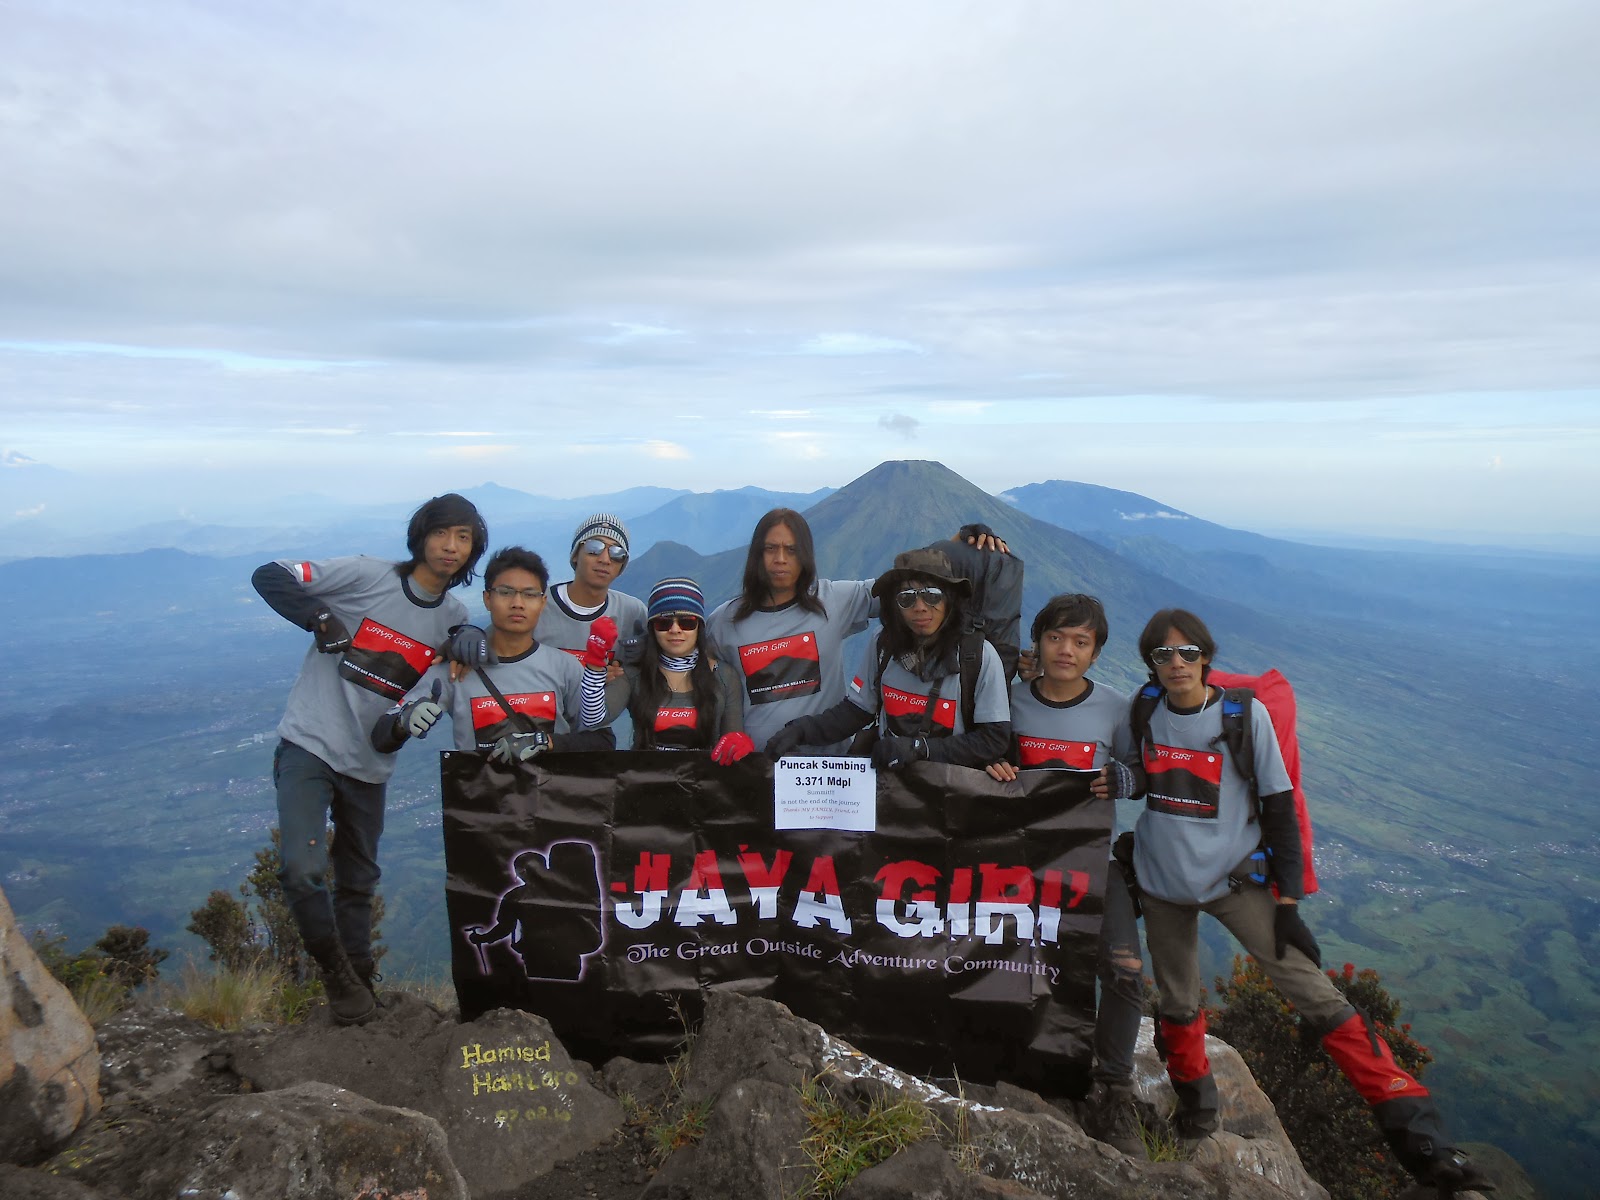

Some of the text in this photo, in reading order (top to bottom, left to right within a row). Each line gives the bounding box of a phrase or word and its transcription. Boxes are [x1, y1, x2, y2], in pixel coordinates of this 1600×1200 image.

[780, 760, 866, 773] Puncak Sumbing
[795, 776, 851, 788] 3.371 Mdpl
[610, 844, 852, 935] JAYA
[627, 938, 1061, 985] The Great Outside Adventure Community
